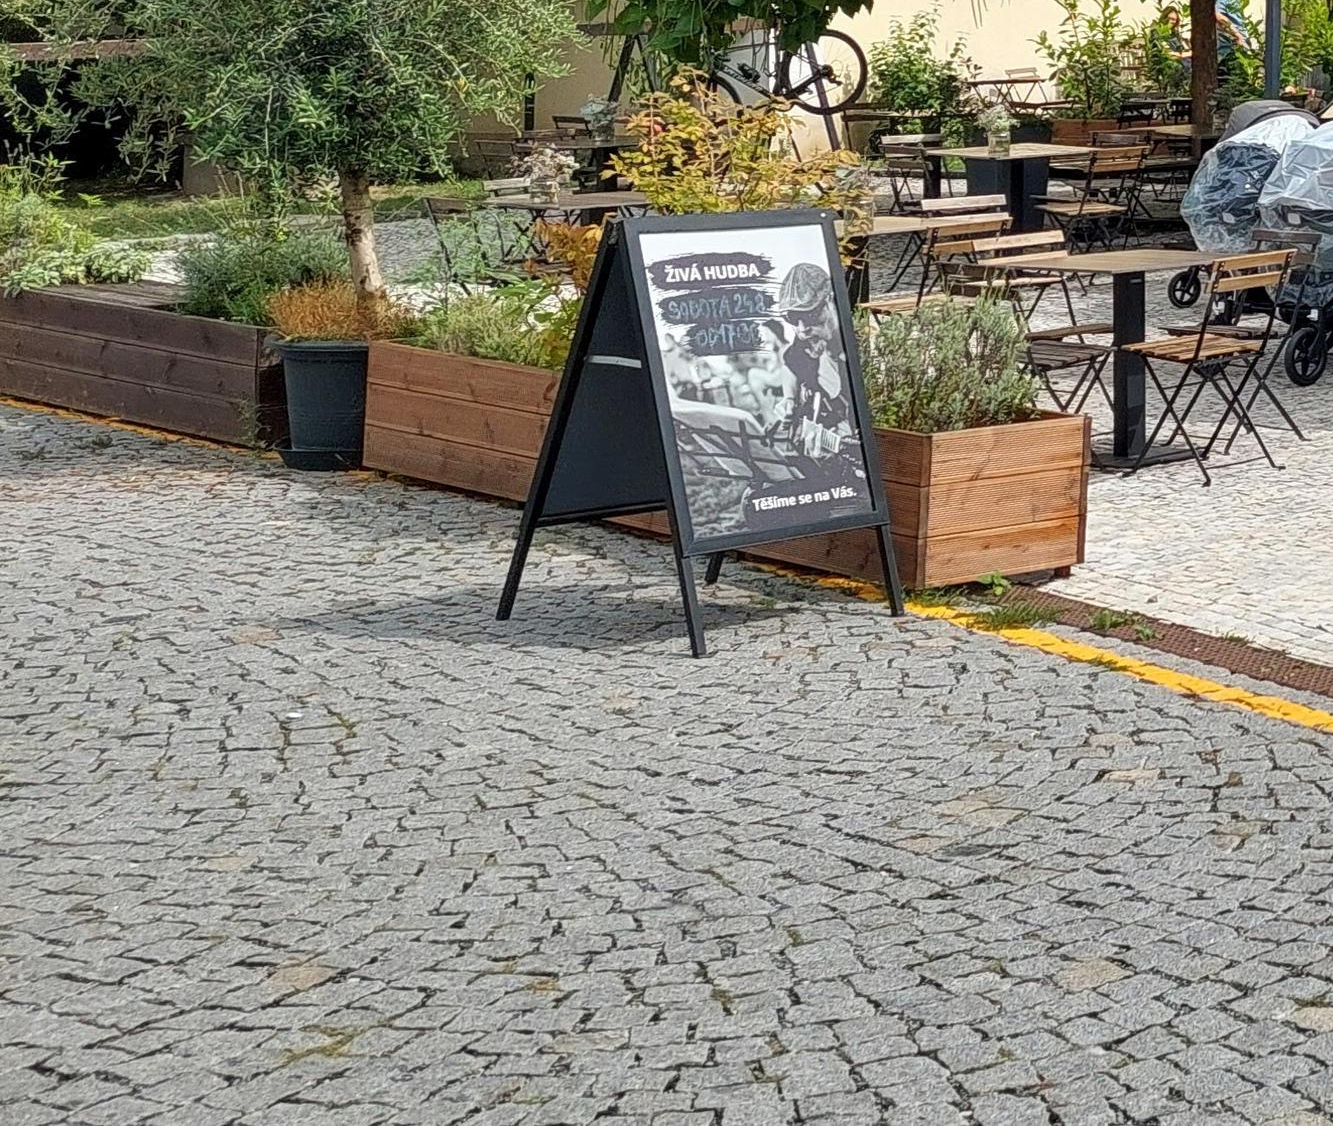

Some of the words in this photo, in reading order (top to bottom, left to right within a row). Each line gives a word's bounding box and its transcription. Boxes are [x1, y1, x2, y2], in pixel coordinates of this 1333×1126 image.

[664, 263, 702, 283] ŽIVÁ
[703, 263, 761, 280] HUDBA
[751, 495, 797, 512] Těšíme
[798, 494, 813, 505] se
[814, 490, 830, 503] na
[830, 485, 858, 500] Vás.
